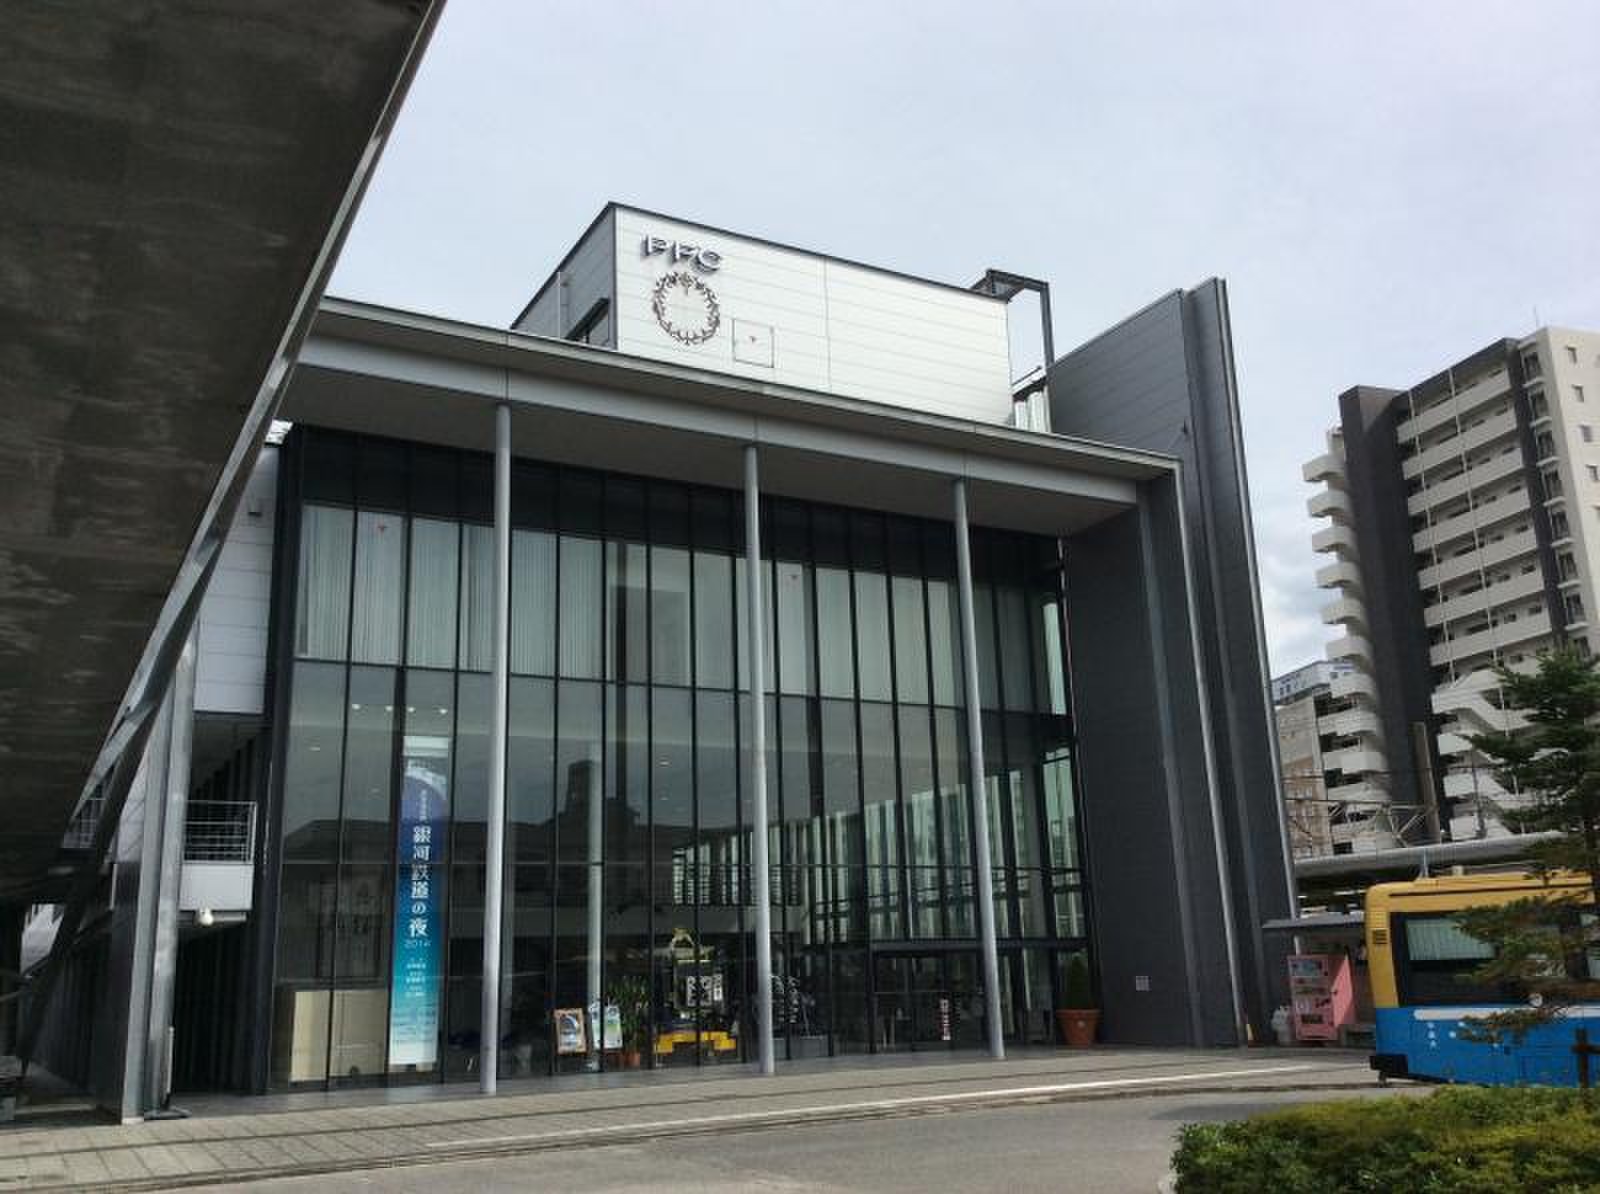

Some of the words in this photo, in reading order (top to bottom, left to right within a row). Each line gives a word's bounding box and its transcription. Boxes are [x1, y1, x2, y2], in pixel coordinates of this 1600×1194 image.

[409, 825, 432, 938] 銀河鉄道の夜
